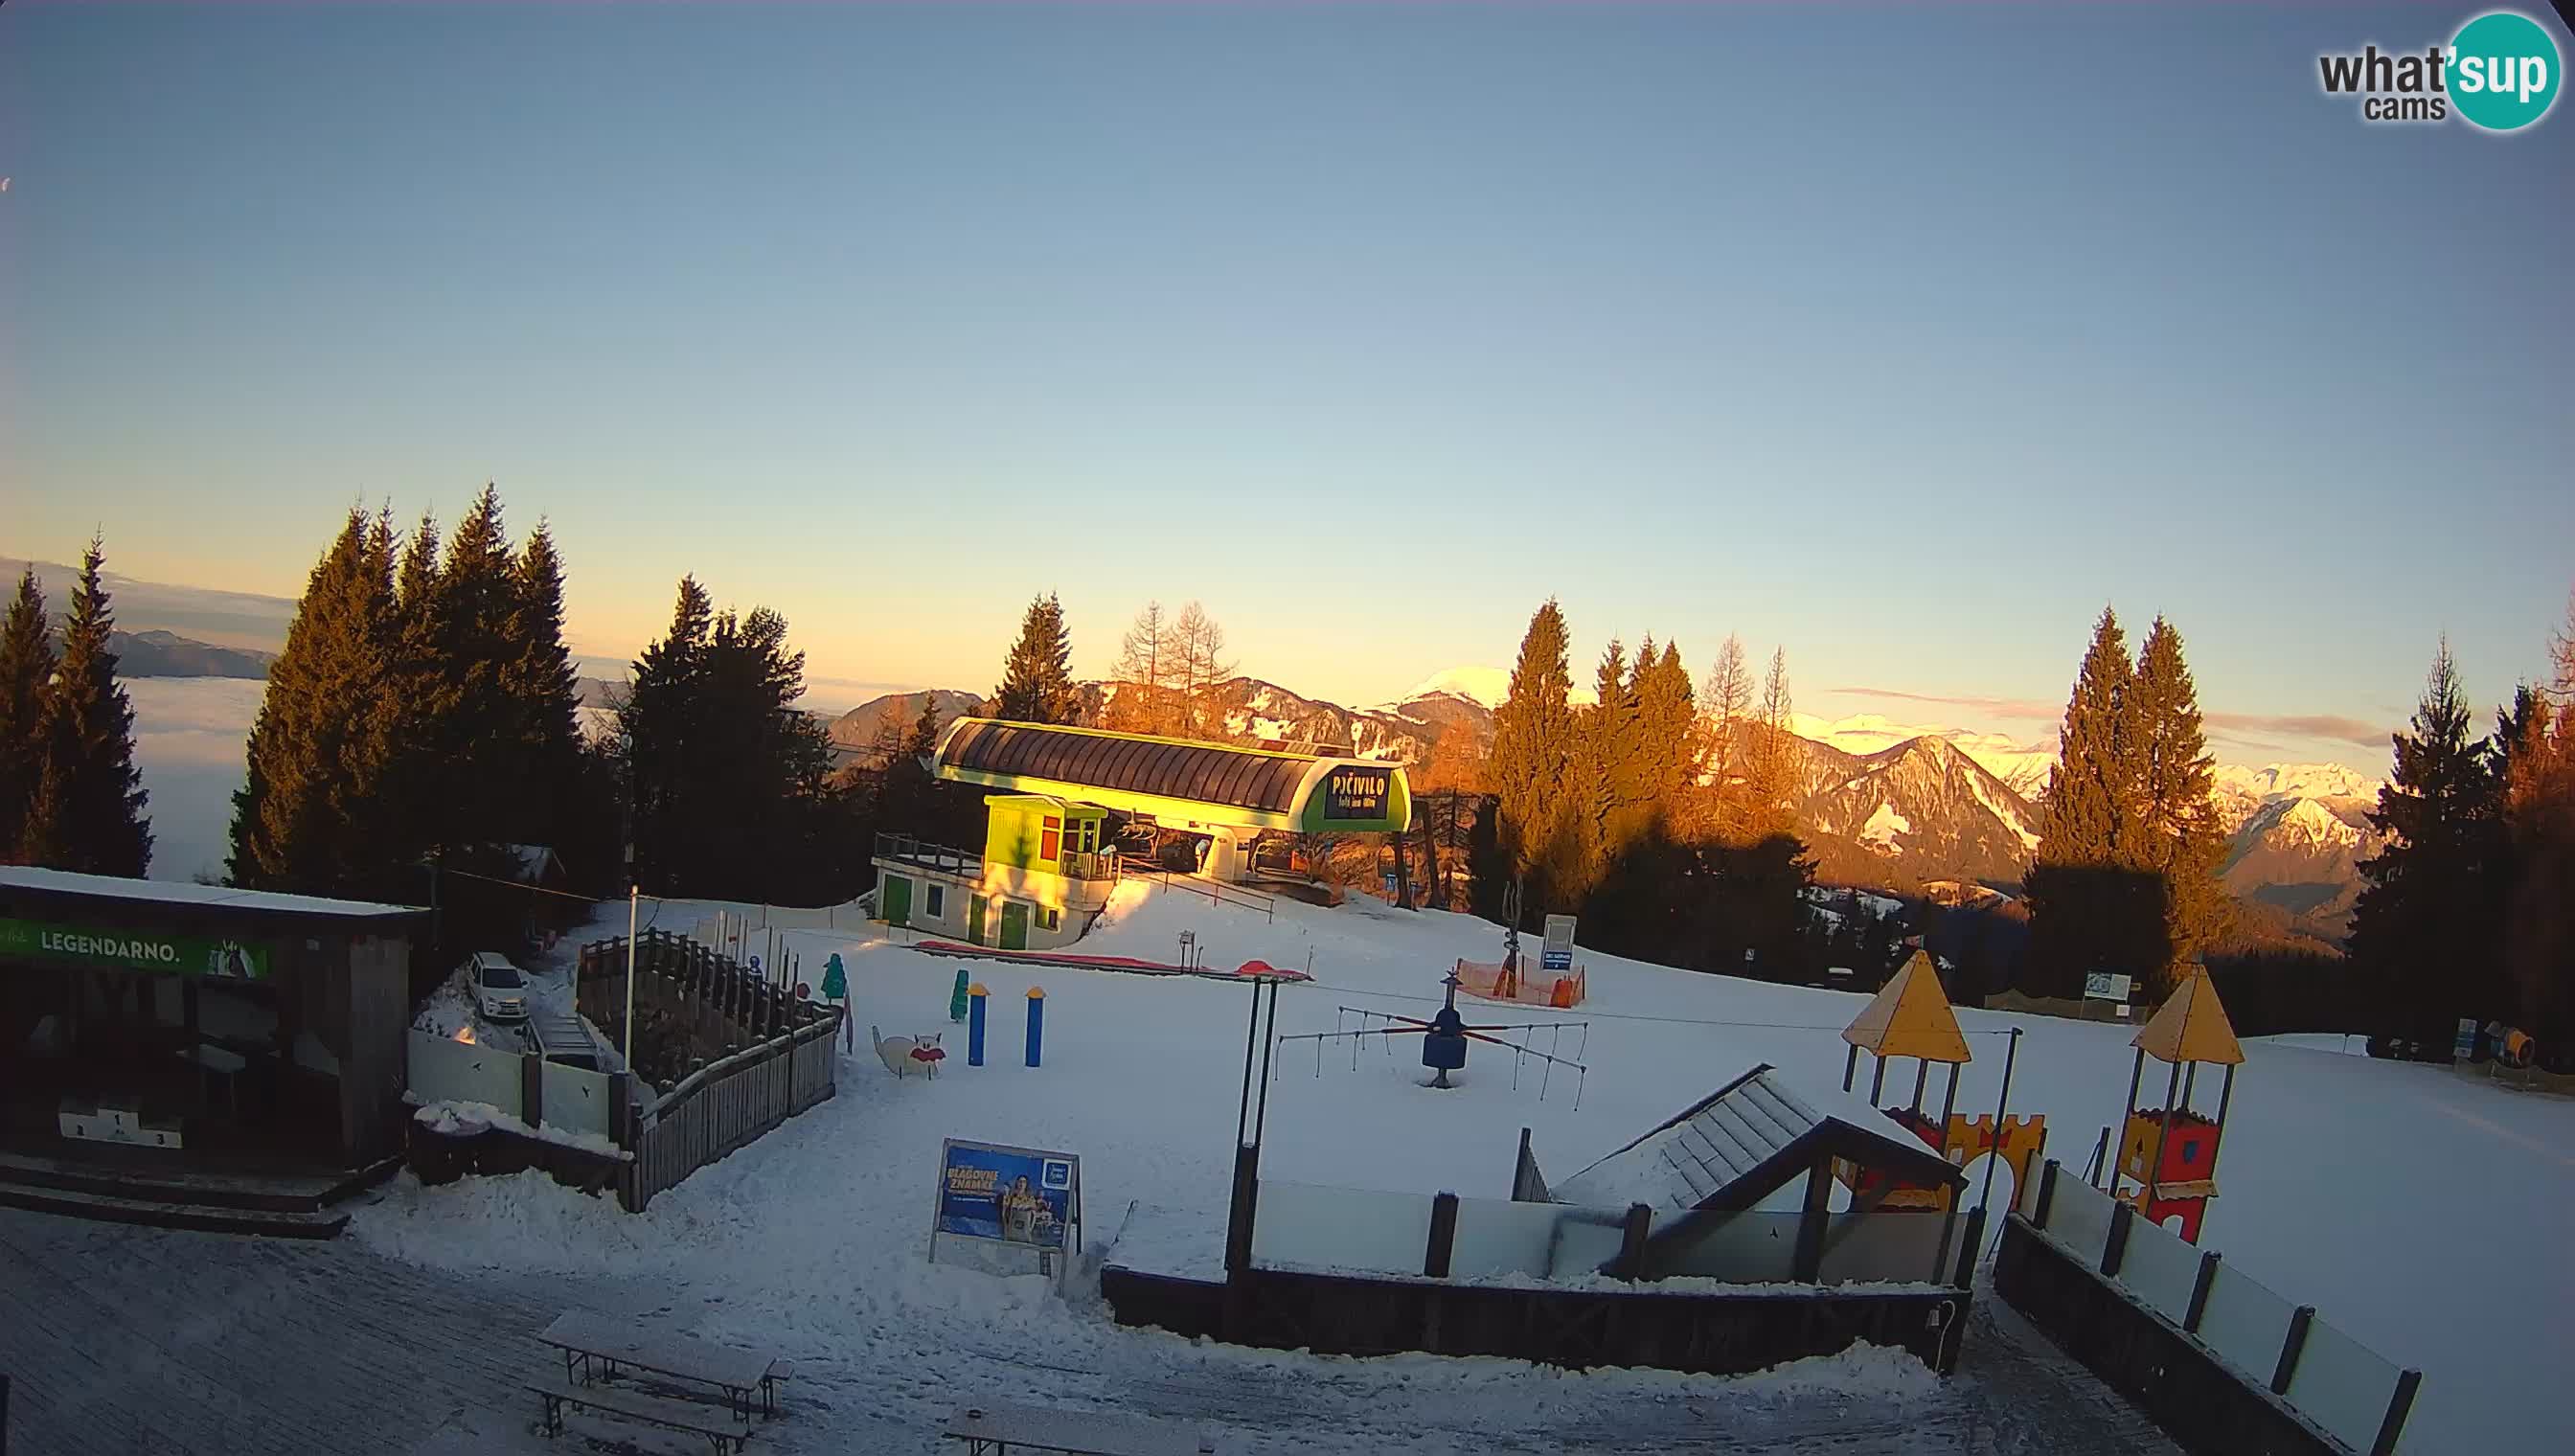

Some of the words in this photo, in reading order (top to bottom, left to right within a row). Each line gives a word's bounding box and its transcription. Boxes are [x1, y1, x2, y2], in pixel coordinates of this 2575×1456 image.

[41, 931, 181, 963] LEGENDARNO.
[115, 1113, 122, 1126] 1
[156, 1133, 166, 1146] 3
